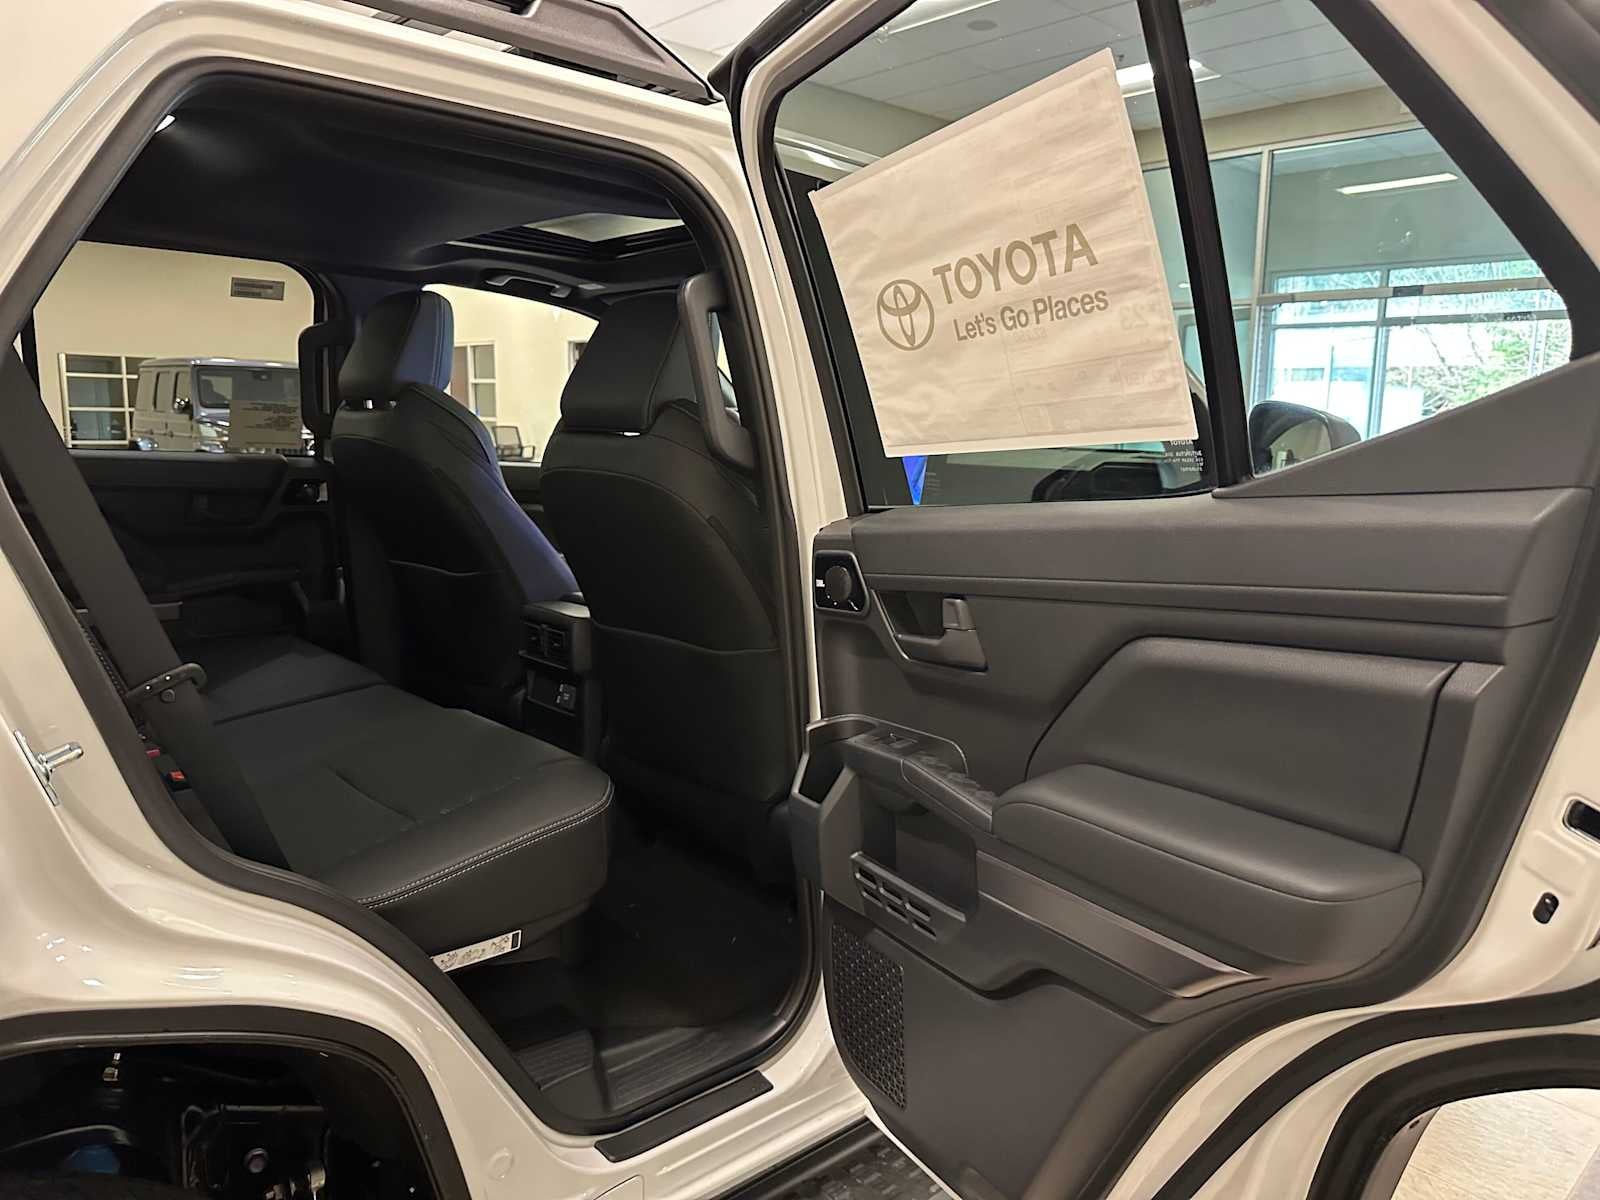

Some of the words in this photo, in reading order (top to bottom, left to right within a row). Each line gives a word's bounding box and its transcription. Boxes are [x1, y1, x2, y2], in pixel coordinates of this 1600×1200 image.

[932, 223, 1098, 304] TOYOTA
[953, 312, 997, 341] Let's
[1000, 306, 1029, 331] Go
[1032, 290, 1109, 325] Places
